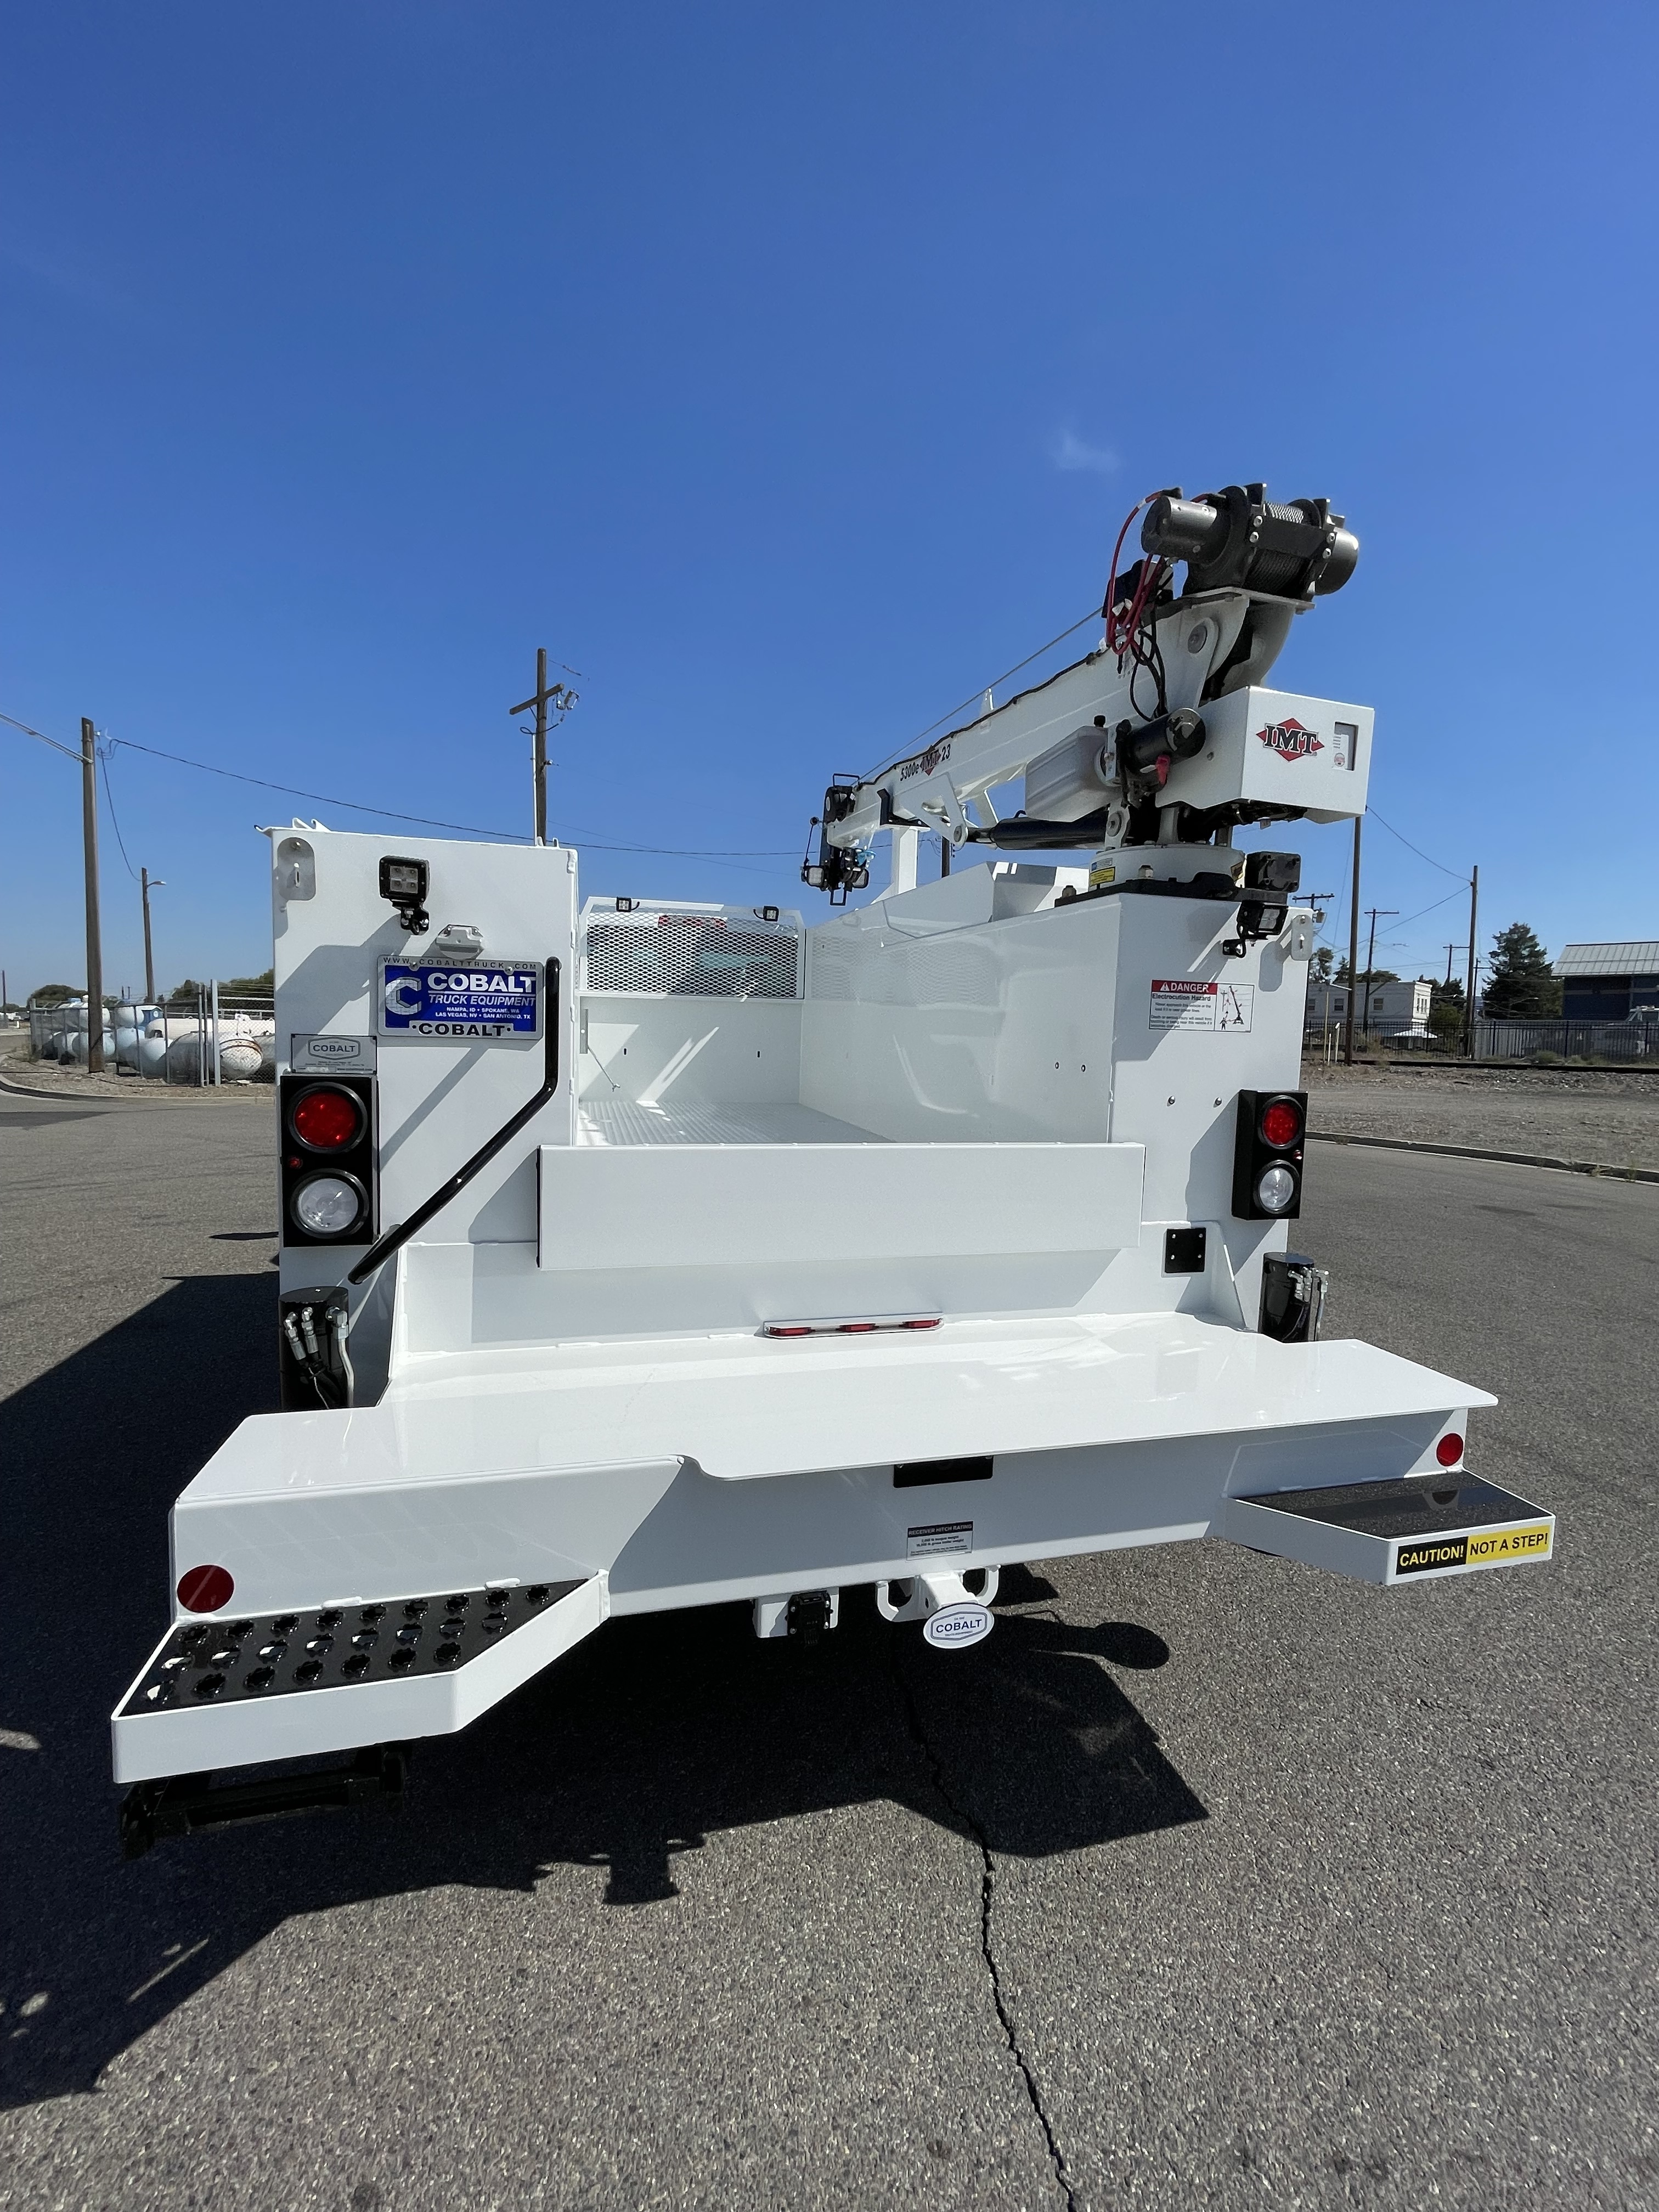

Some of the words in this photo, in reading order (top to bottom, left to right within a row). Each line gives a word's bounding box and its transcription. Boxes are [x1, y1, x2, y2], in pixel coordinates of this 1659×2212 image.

[1264, 725, 1317, 754] IMT
[922, 749, 939, 771] IMT
[941, 743, 951, 761] 23
[428, 972, 537, 992] COBALT
[1170, 983, 1209, 993] DANGER
[428, 994, 467, 1005] TRUCK
[470, 996, 536, 1007] EQUIPMENT
[419, 1023, 505, 1036] COBALT
[1400, 1545, 1464, 1567] CAUTION!
[1470, 1540, 1498, 1556] NOT
[1499, 1539, 1509, 1551] A
[1512, 1533, 1548, 1549] STEP!
[936, 1619, 982, 1633] COBALT
